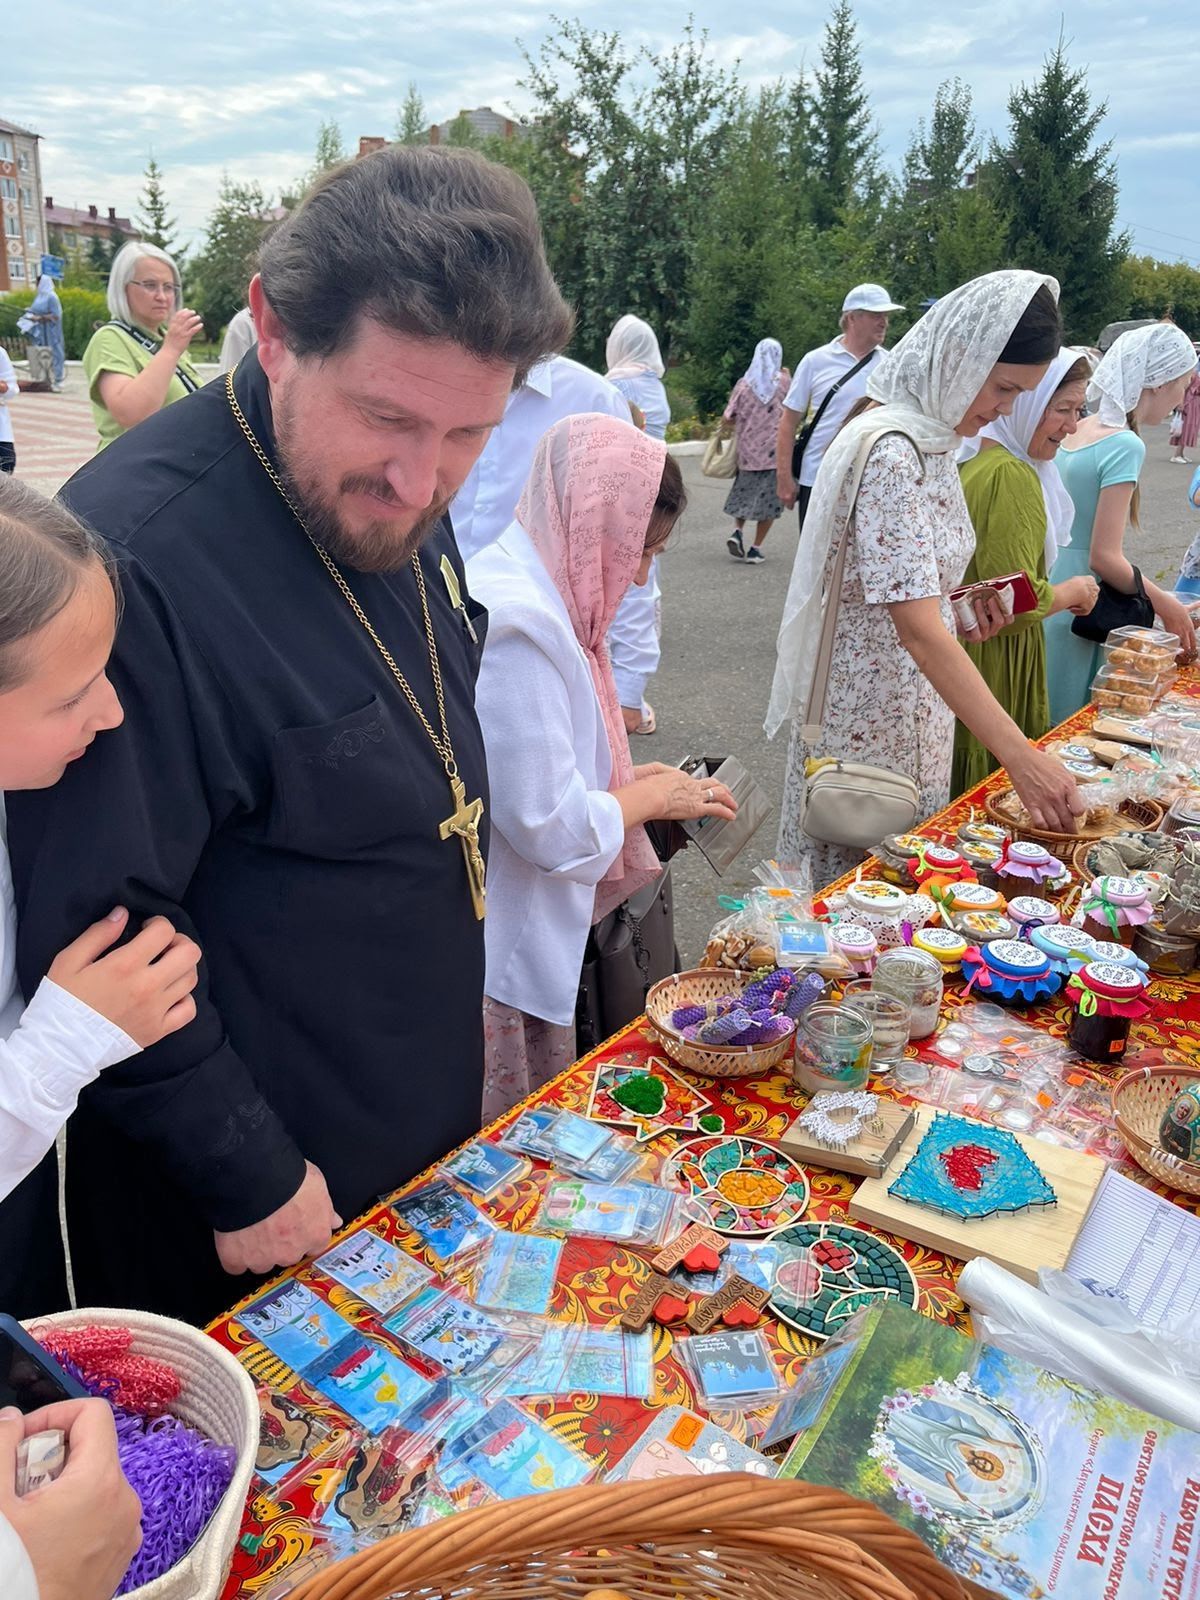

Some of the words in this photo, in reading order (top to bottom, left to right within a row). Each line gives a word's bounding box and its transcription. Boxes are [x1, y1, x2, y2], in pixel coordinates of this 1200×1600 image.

[1088, 1428, 1104, 1456] Серия
[1134, 1430, 1157, 1485] СВЕТЛОЕ
[1077, 1473, 1124, 1567] ПАСХА
[1118, 1485, 1144, 1547] ХРИСТОВО
[1172, 1477, 1200, 1556] РАБОЧАЯ
